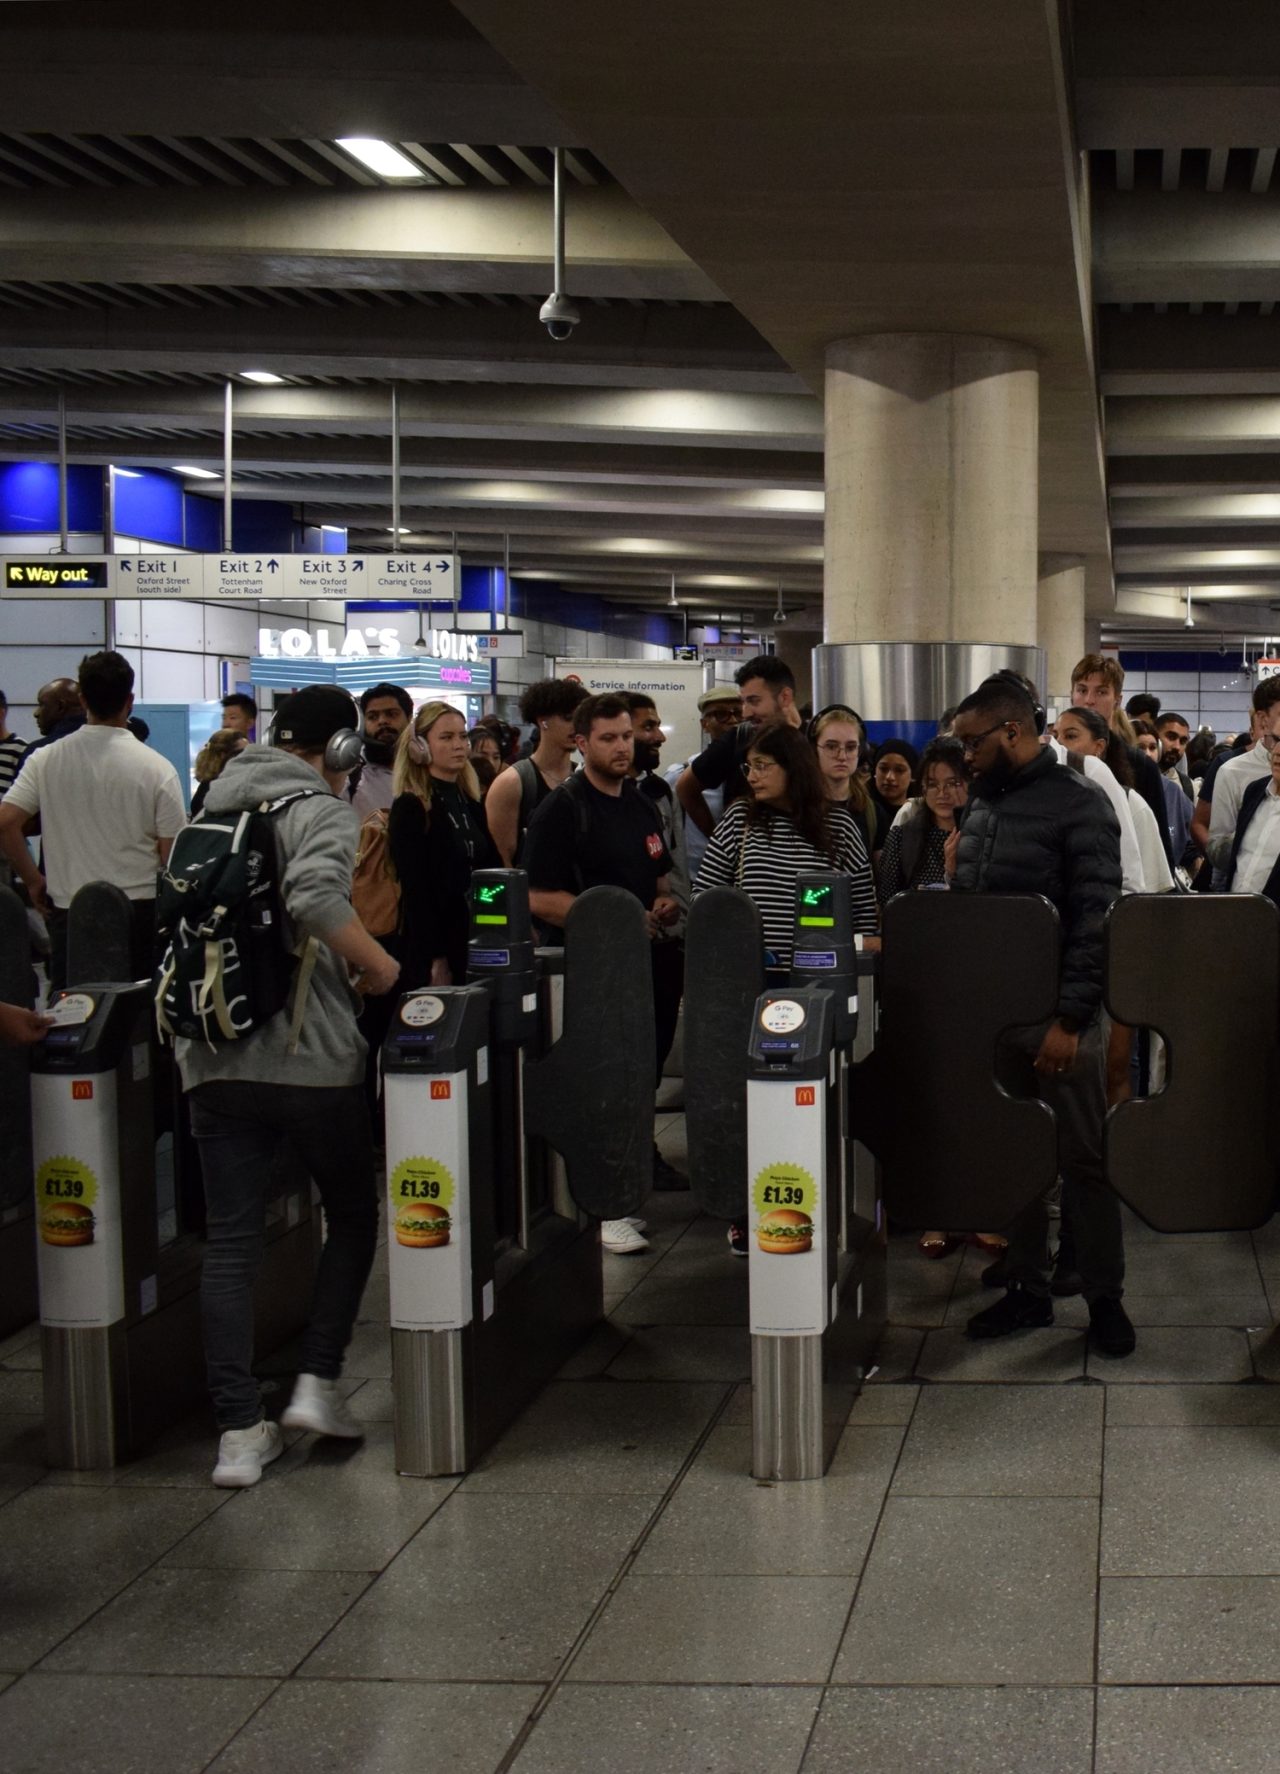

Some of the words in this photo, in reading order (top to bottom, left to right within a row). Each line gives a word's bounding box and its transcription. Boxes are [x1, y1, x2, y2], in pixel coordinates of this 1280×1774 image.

[138, 560, 167, 573] Exit
[173, 560, 177, 573] 1
[220, 560, 249, 573] Exit
[255, 560, 263, 573] 2
[303, 560, 332, 573] Exit
[338, 560, 347, 573] 3
[387, 560, 416, 573] Exit
[422, 560, 432, 573] 4
[26, 567, 58, 584] Way
[61, 568, 88, 581] out
[137, 577, 164, 585] Oxford
[166, 577, 190, 585] Street
[221, 578, 263, 586] Tottenham
[299, 578, 318, 586] New
[320, 578, 347, 586] Oxford
[378, 578, 407, 587] Charing
[410, 578, 432, 586] Cross
[136, 586, 162, 594] (south
[164, 586, 182, 594] side)
[323, 587, 347, 595] Street
[259, 627, 400, 656] LOLA'S
[590, 680, 624, 689] Service
[628, 681, 685, 691] information
[45, 1178, 83, 1198] £1.39
[400, 1179, 440, 1198] £1.39
[763, 1186, 804, 1205] £1.39
